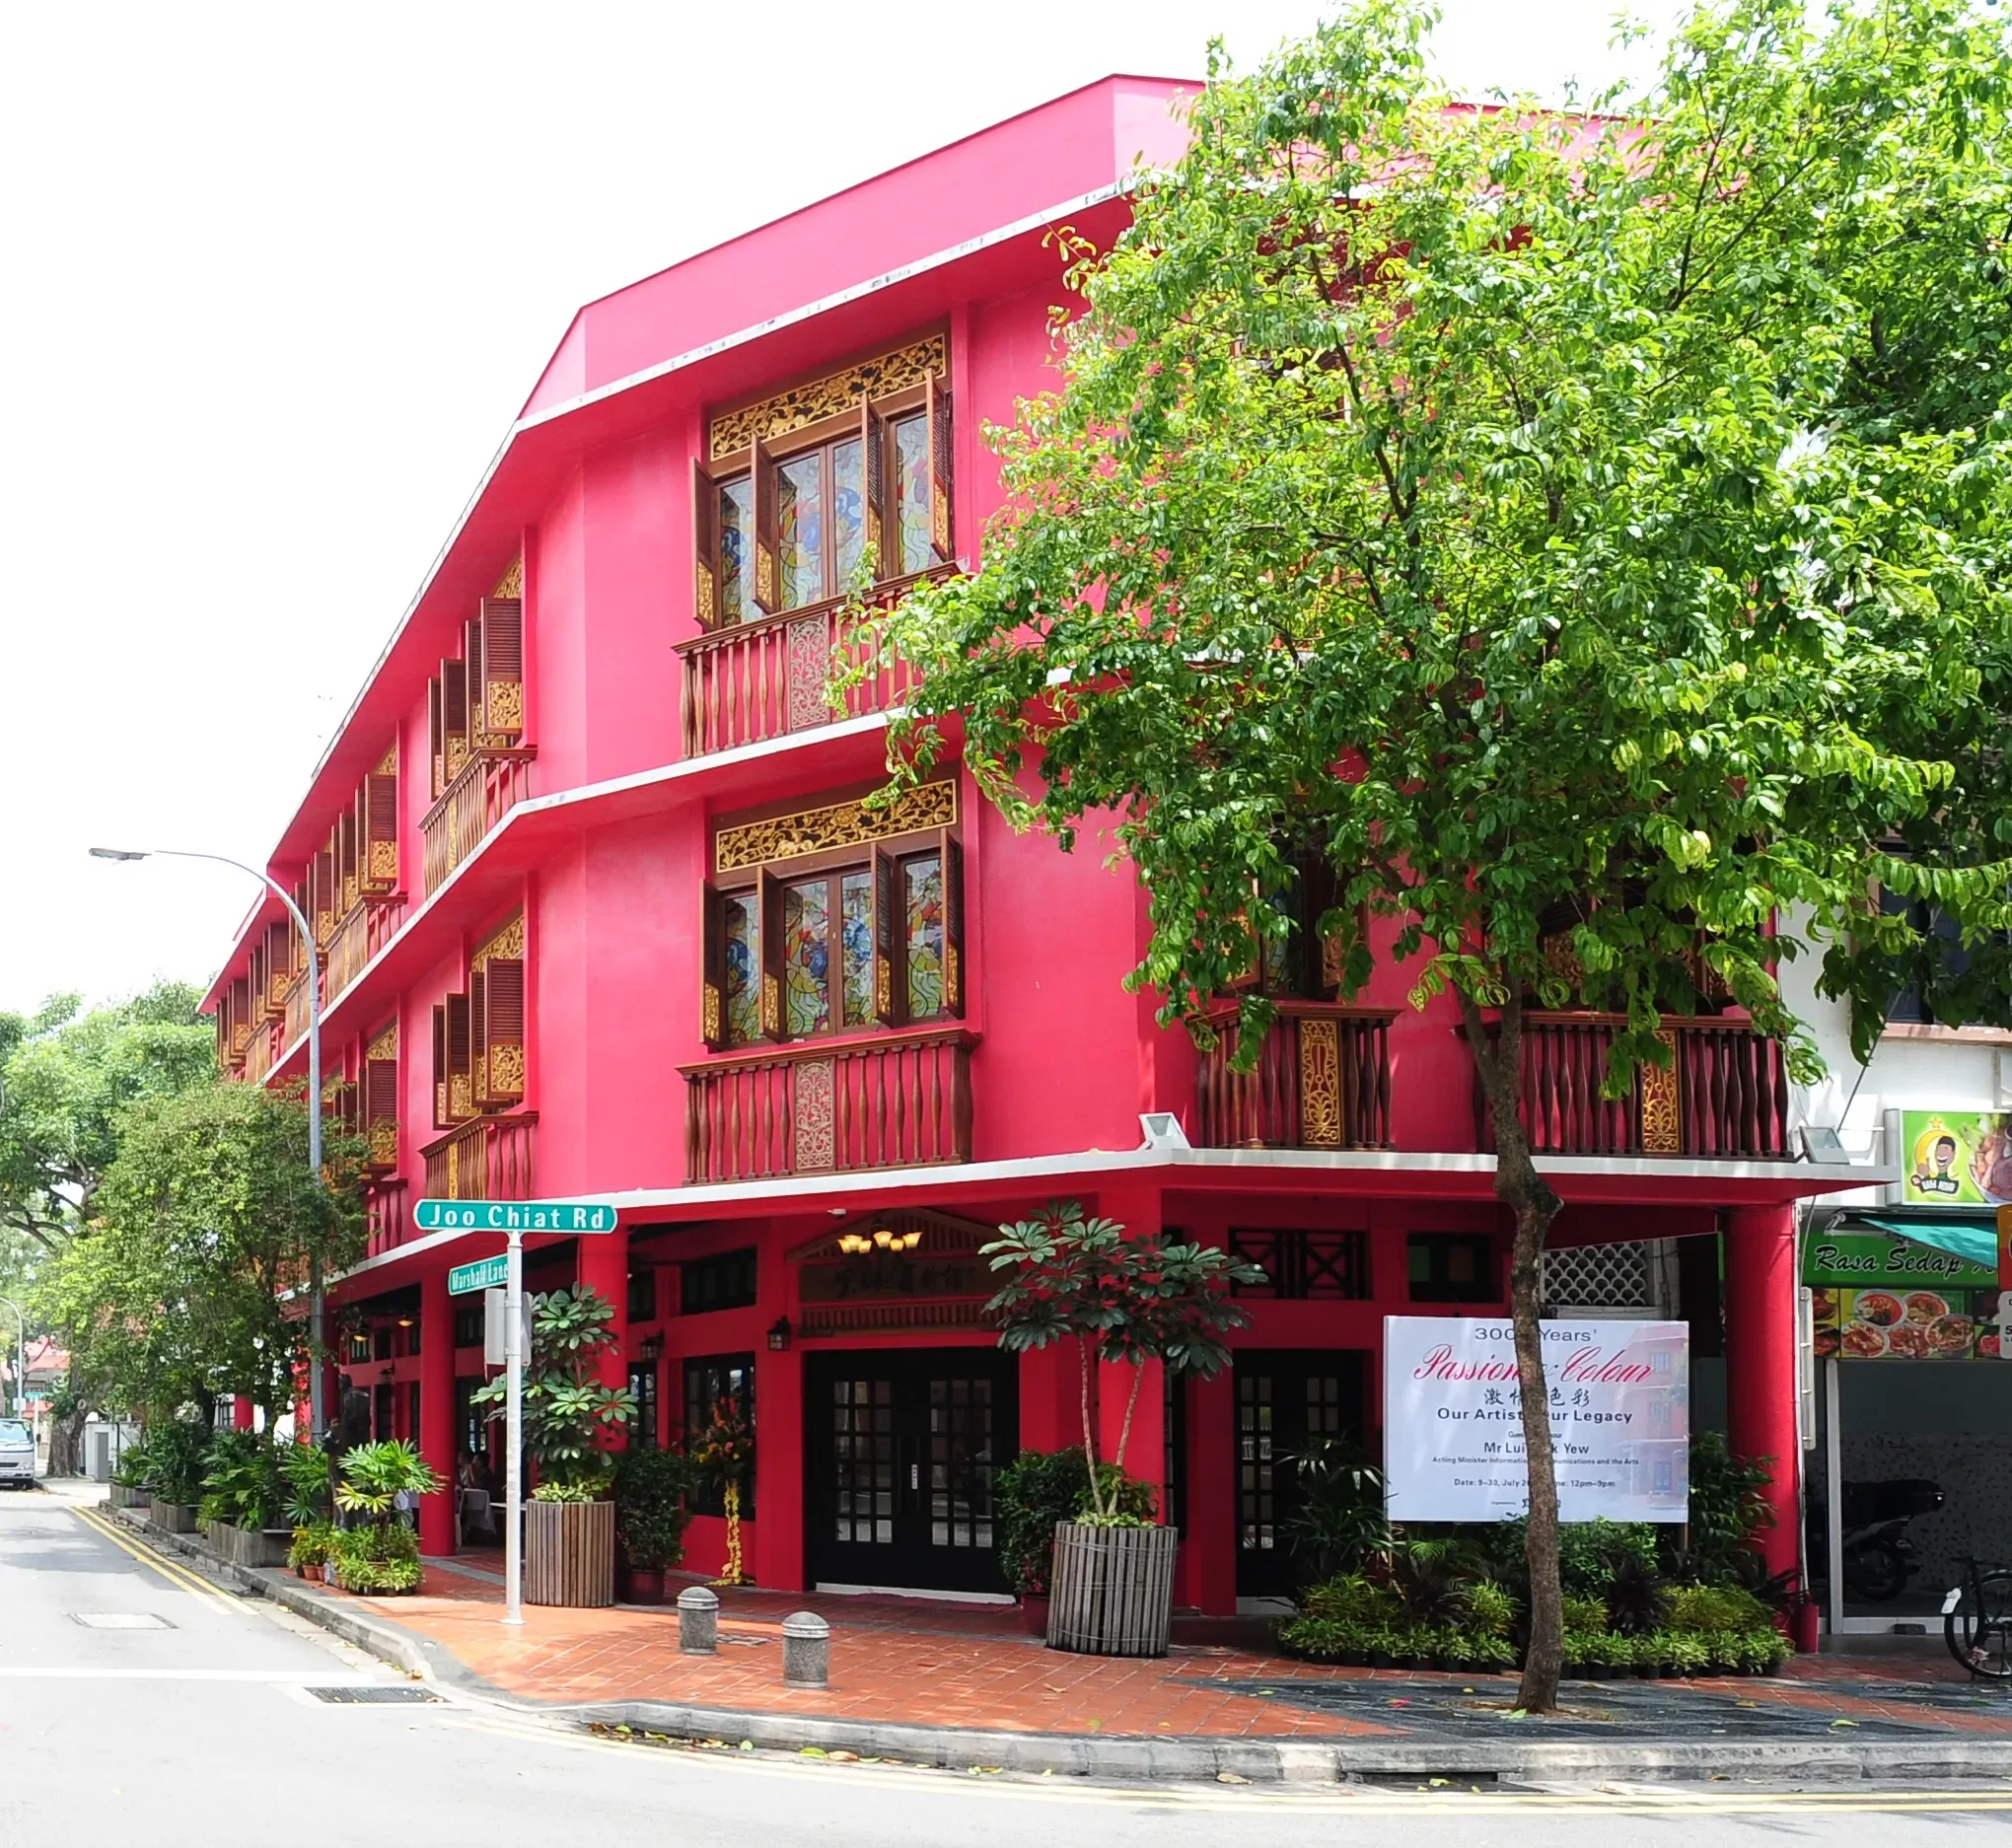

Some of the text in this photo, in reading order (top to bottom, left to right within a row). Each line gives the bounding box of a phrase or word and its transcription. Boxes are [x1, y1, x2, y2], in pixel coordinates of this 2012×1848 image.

[430, 1204, 604, 1229] Joo Chiat Rd
[1814, 1244, 1964, 1279] Rasa Sedap
[452, 1264, 486, 1290] Marshall
[1560, 1346, 1656, 1383] Colour
[1437, 1407, 1469, 1419] Our
[1573, 1410, 1632, 1424] Legacy
[1484, 1442, 1502, 1453] Mr
[1563, 1444, 1589, 1454] Yew
